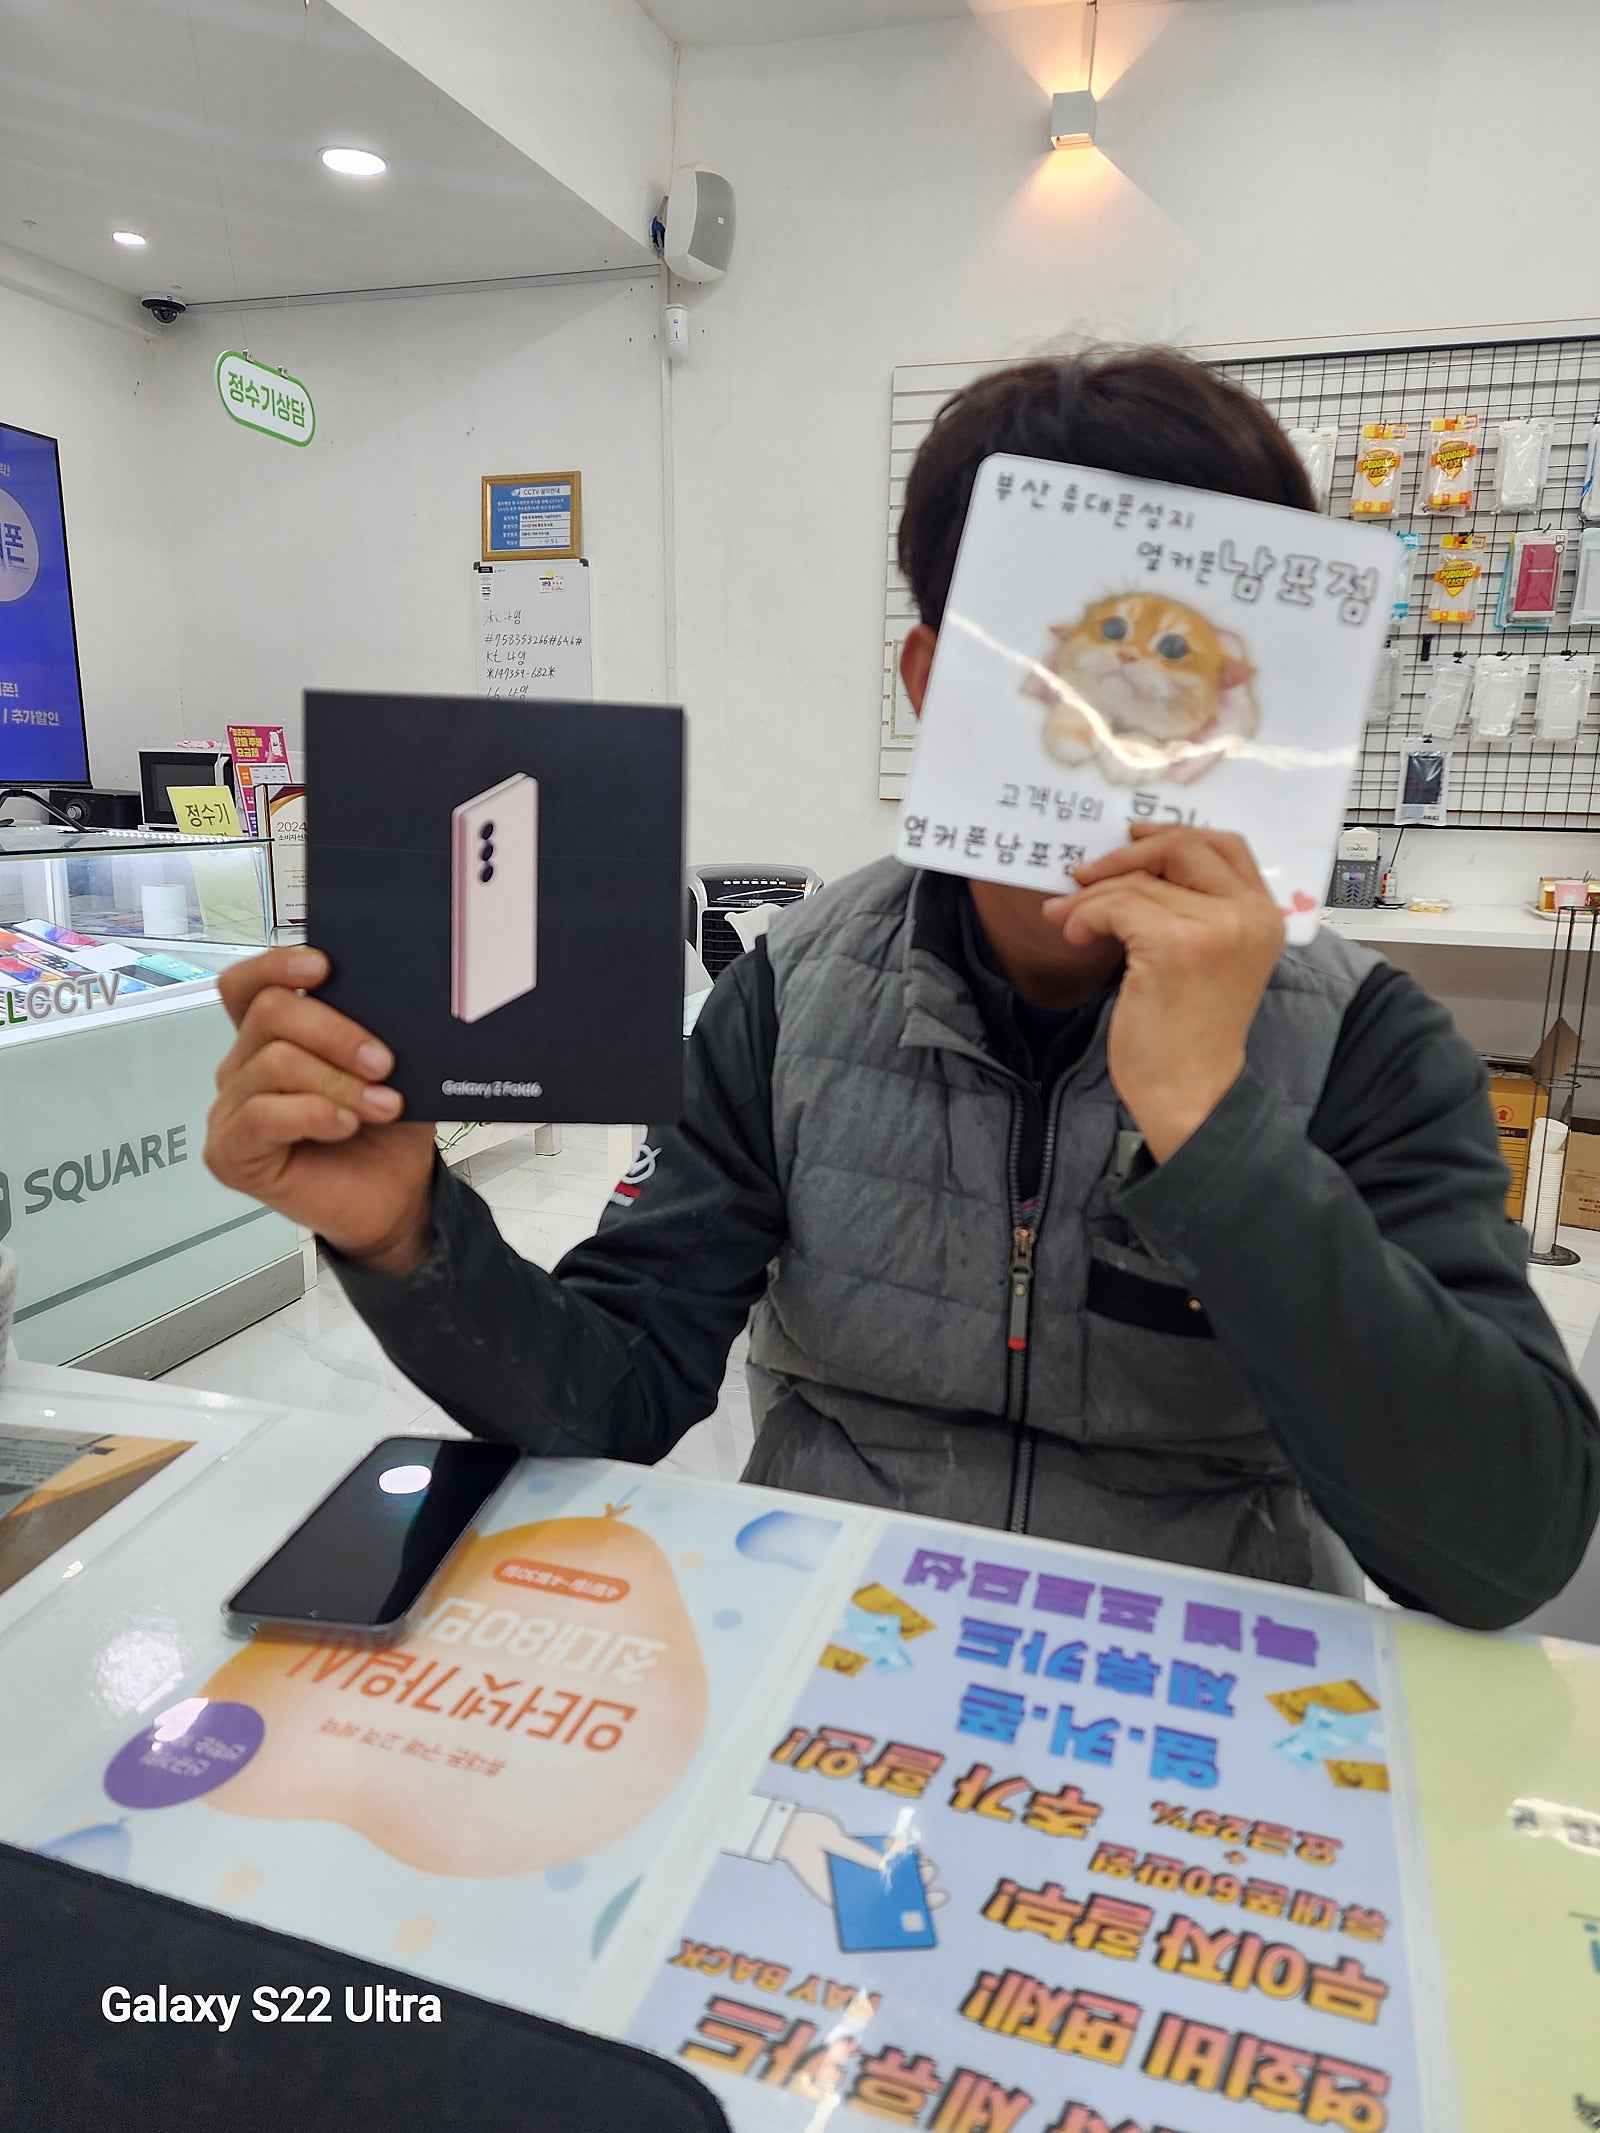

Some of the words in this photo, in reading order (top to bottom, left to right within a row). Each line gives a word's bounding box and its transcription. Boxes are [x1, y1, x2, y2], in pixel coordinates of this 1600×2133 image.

[228, 370, 305, 428] 정수기상담
[1363, 458, 1395, 470] PUDDING
[1436, 449, 1470, 462] PUDDING
[0, 522, 25, 563] 폰
[1439, 568, 1474, 579] PUDDING
[0, 681, 19, 698] 폰!
[11, 708, 60, 726] 추가할인
[185, 803, 231, 827] 정수기
[278, 833, 307, 843] 소비자선
[442, 1080, 492, 1099] Galaxy
[24, 1124, 188, 1215] SQUARE
[285, 1632, 638, 1753] 인터넷가입시
[955, 1616, 1238, 1718] 제휴카드
[771, 1726, 946, 1799] 할인!
[949, 1761, 1105, 1840] 추가
[1151, 1800, 1344, 1867] 요금25%
[983, 1877, 1155, 1961] 할부!
[1088, 1841, 1392, 1944] 휴대폰60만원
[667, 1938, 793, 1995] BACK
[1154, 1913, 1390, 2026] 무이자
[959, 1967, 1146, 2068] 면제!
[1142, 2011, 1394, 2133] 연회비
